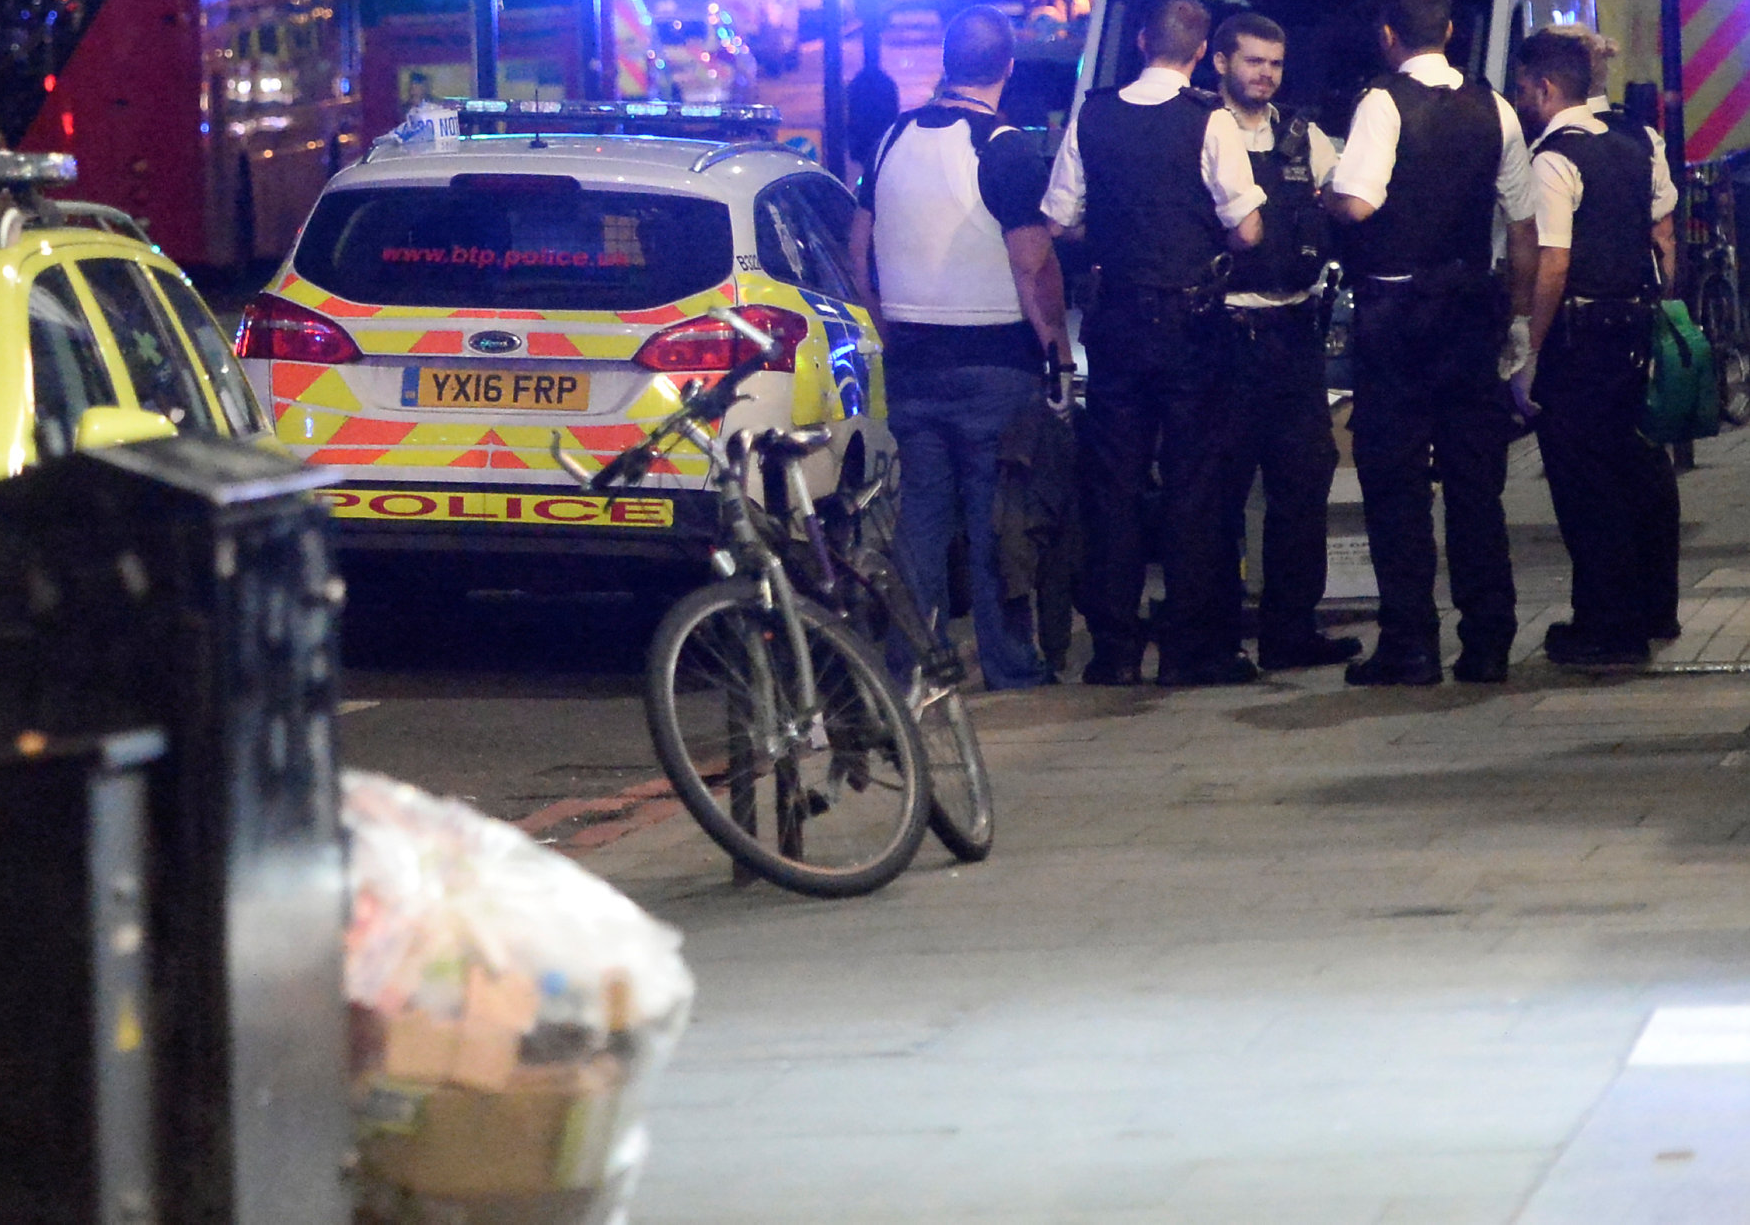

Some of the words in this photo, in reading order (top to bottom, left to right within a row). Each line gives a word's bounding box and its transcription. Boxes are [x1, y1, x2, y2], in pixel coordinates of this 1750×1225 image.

[381, 245, 630, 269] www.btp.police.uk
[432, 373, 503, 403] YX16
[513, 376, 577, 404] FRP
[313, 492, 665, 524] POLICE
